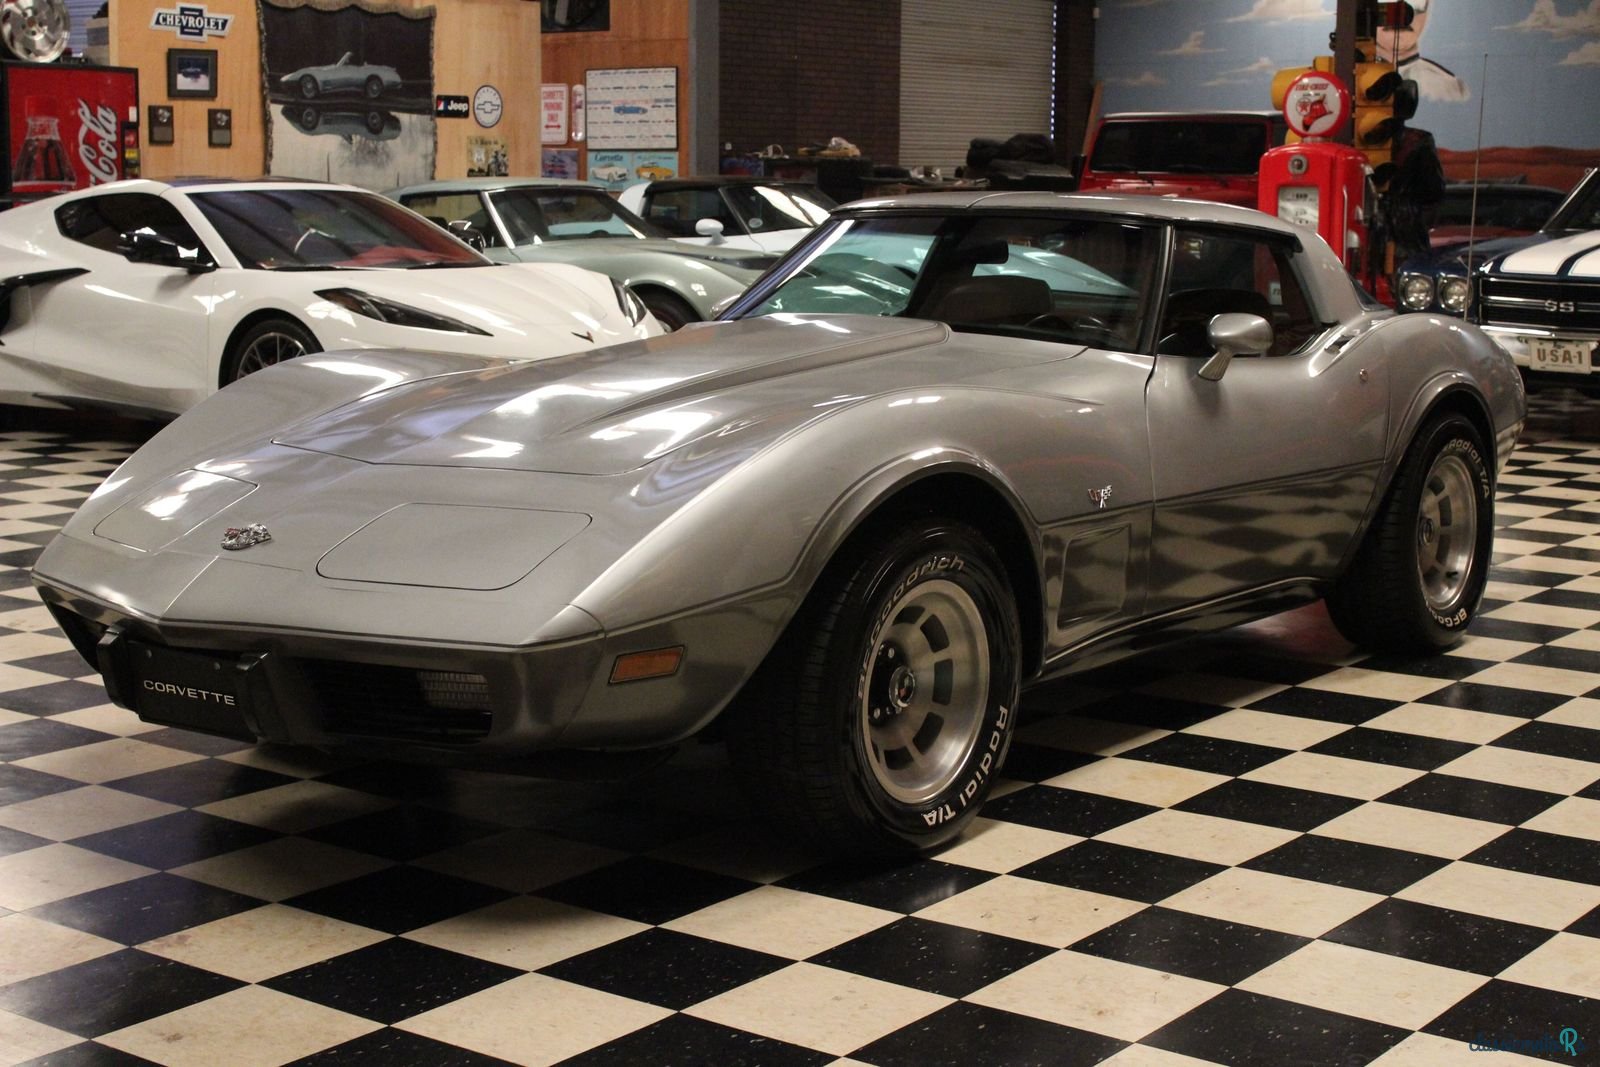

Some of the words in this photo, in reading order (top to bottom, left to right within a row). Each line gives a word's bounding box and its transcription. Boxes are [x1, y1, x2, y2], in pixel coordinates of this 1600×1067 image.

[159, 14, 224, 31] CHEVROLET
[447, 100, 469, 112] Jeep
[1544, 299, 1575, 313] SS
[1448, 438, 1481, 464] Radial
[1479, 465, 1491, 499] T/A
[143, 679, 236, 706] CORVETTE
[958, 703, 1009, 808] Radial
[921, 808, 957, 827] T/A
